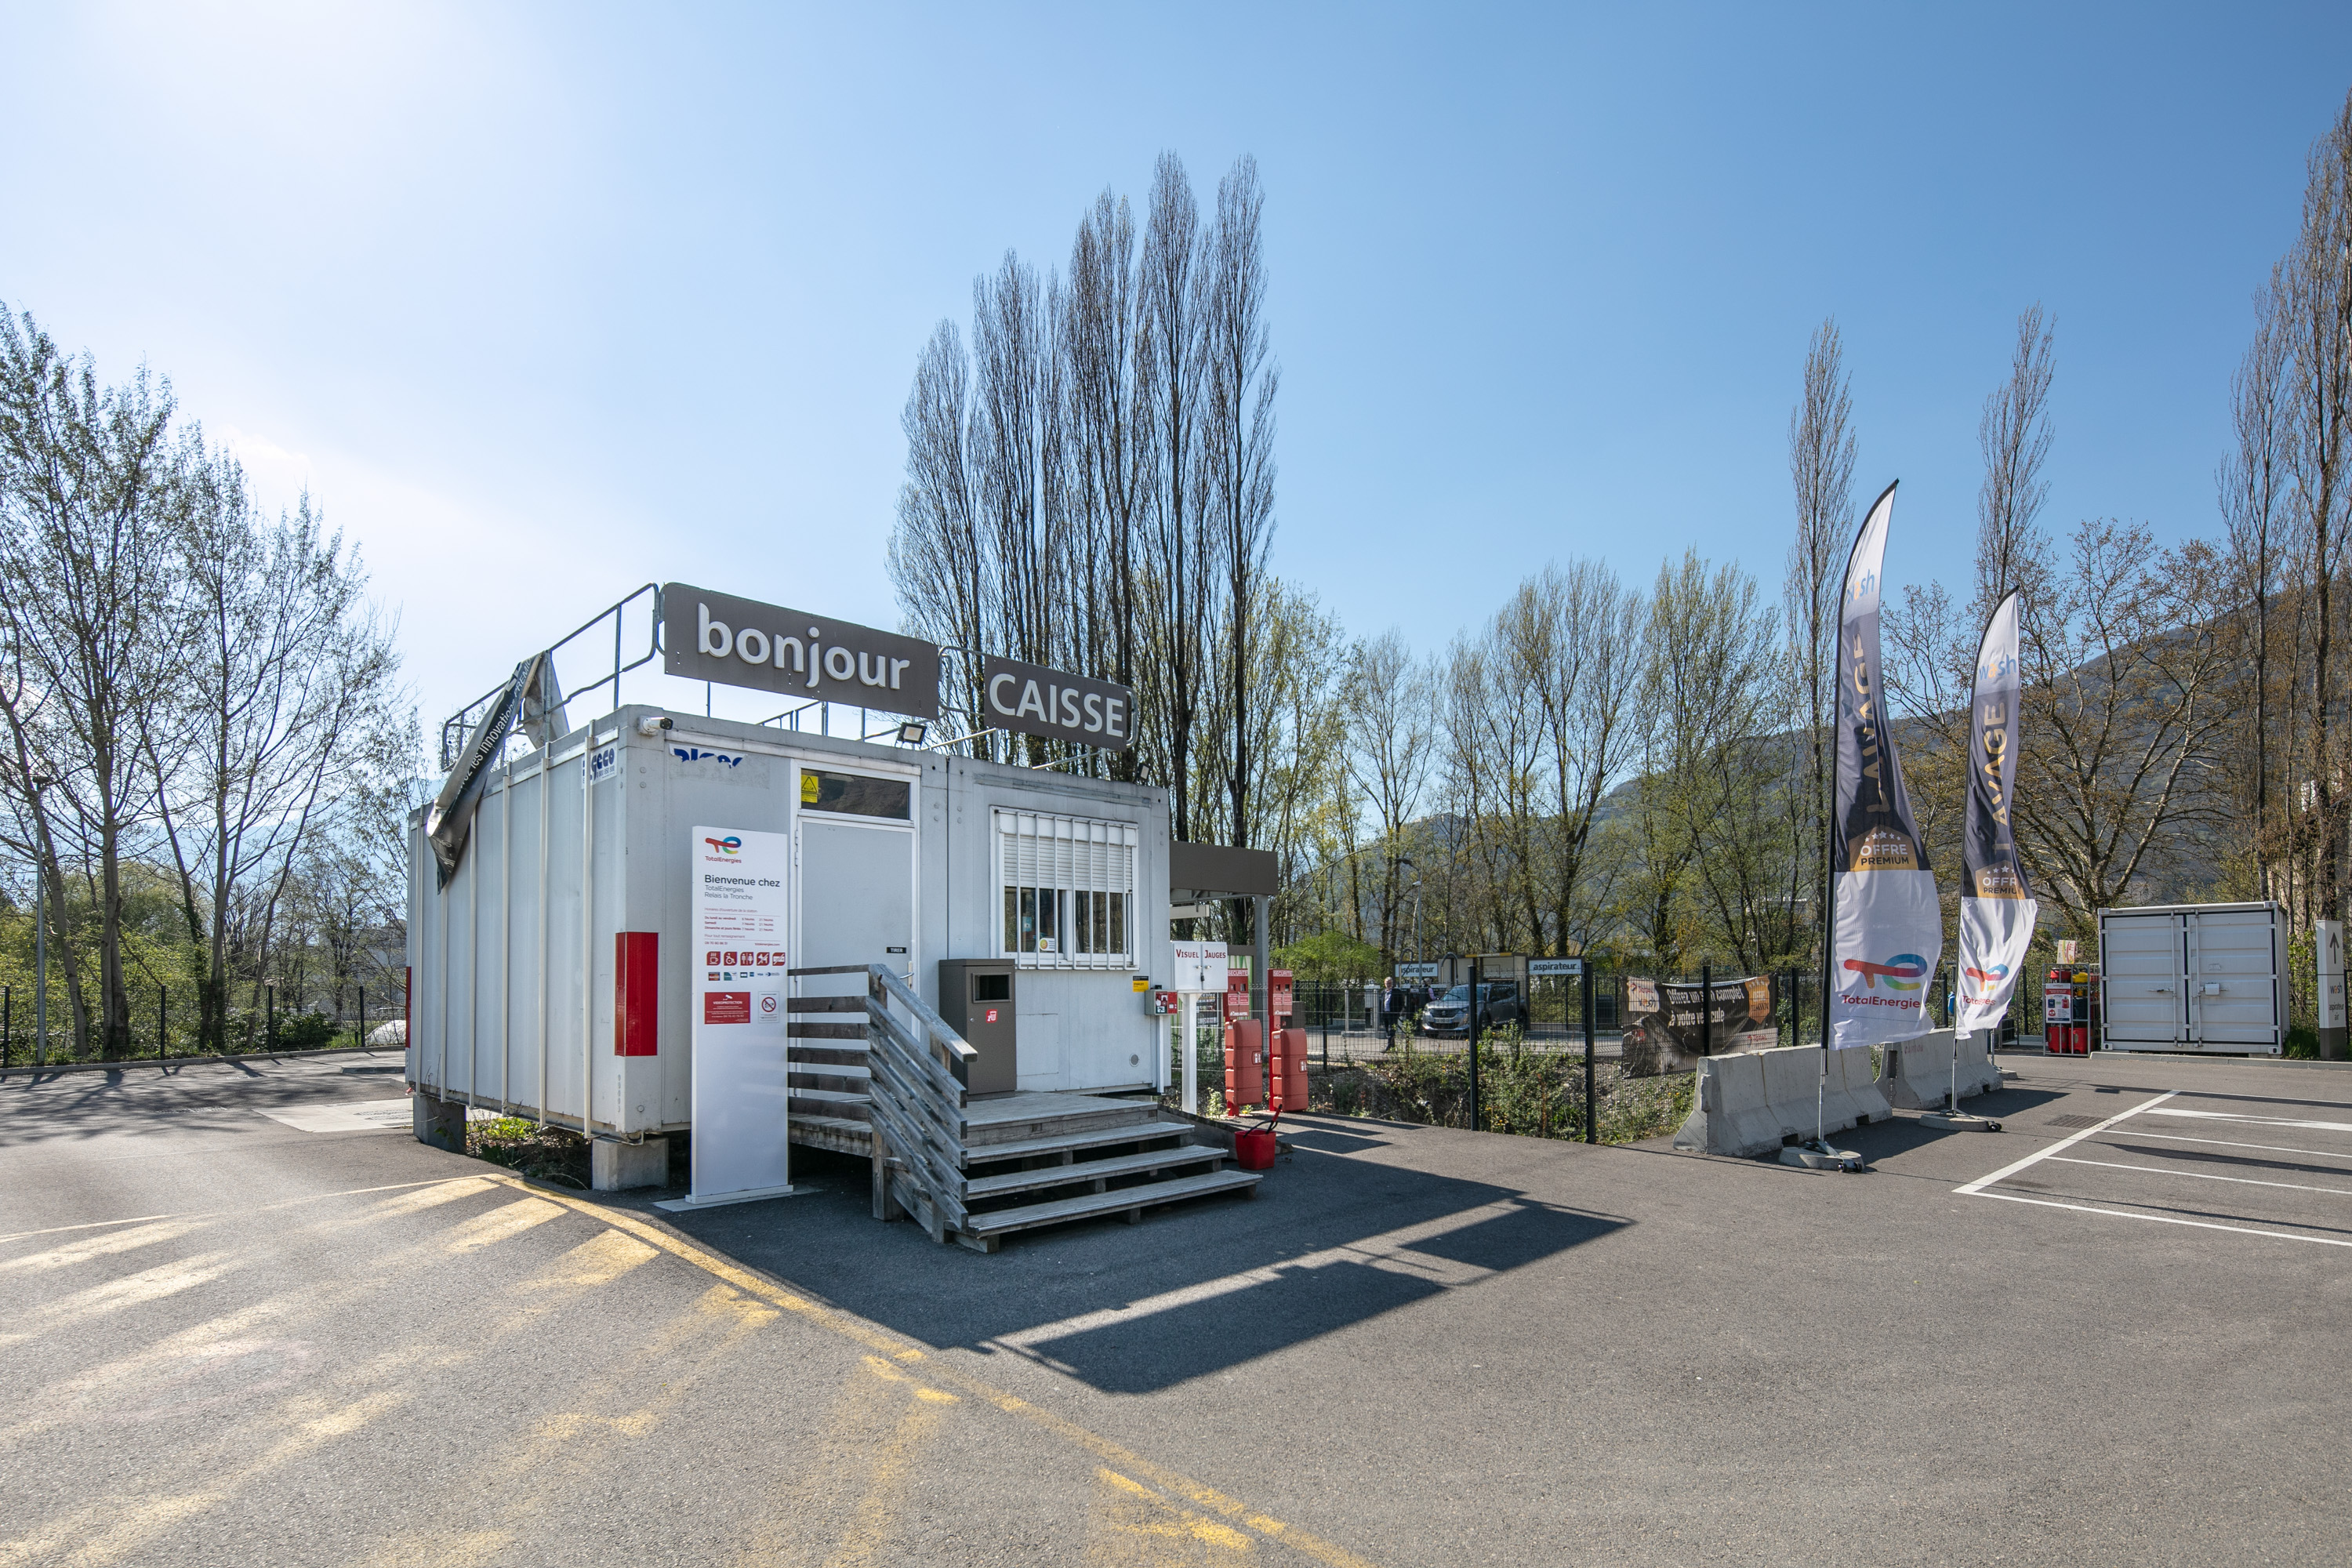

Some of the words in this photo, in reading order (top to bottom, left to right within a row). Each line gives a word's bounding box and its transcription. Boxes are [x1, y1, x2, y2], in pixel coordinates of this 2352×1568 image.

[698, 602, 910, 690] bonjour
[1980, 654, 2016, 681] wash
[989, 673, 1124, 738] CAISSE
[1860, 844, 1907, 856] OFFRE
[1860, 857, 1909, 866] PREMIUM
[705, 874, 755, 886] Bienvenue
[758, 878, 780, 887] chez
[1983, 877, 2016, 887] OFFR
[1176, 949, 1199, 958] VISUEL
[1533, 961, 1577, 973] aspirateur
[2330, 982, 2342, 994] wash
[1666, 989, 1690, 1004] Offrez
[1715, 985, 1744, 1003] complet
[1842, 994, 1920, 1010] TotalEnergie
[2329, 1002, 2344, 1012] aspirateur
[1676, 1011, 1696, 1026] votre
